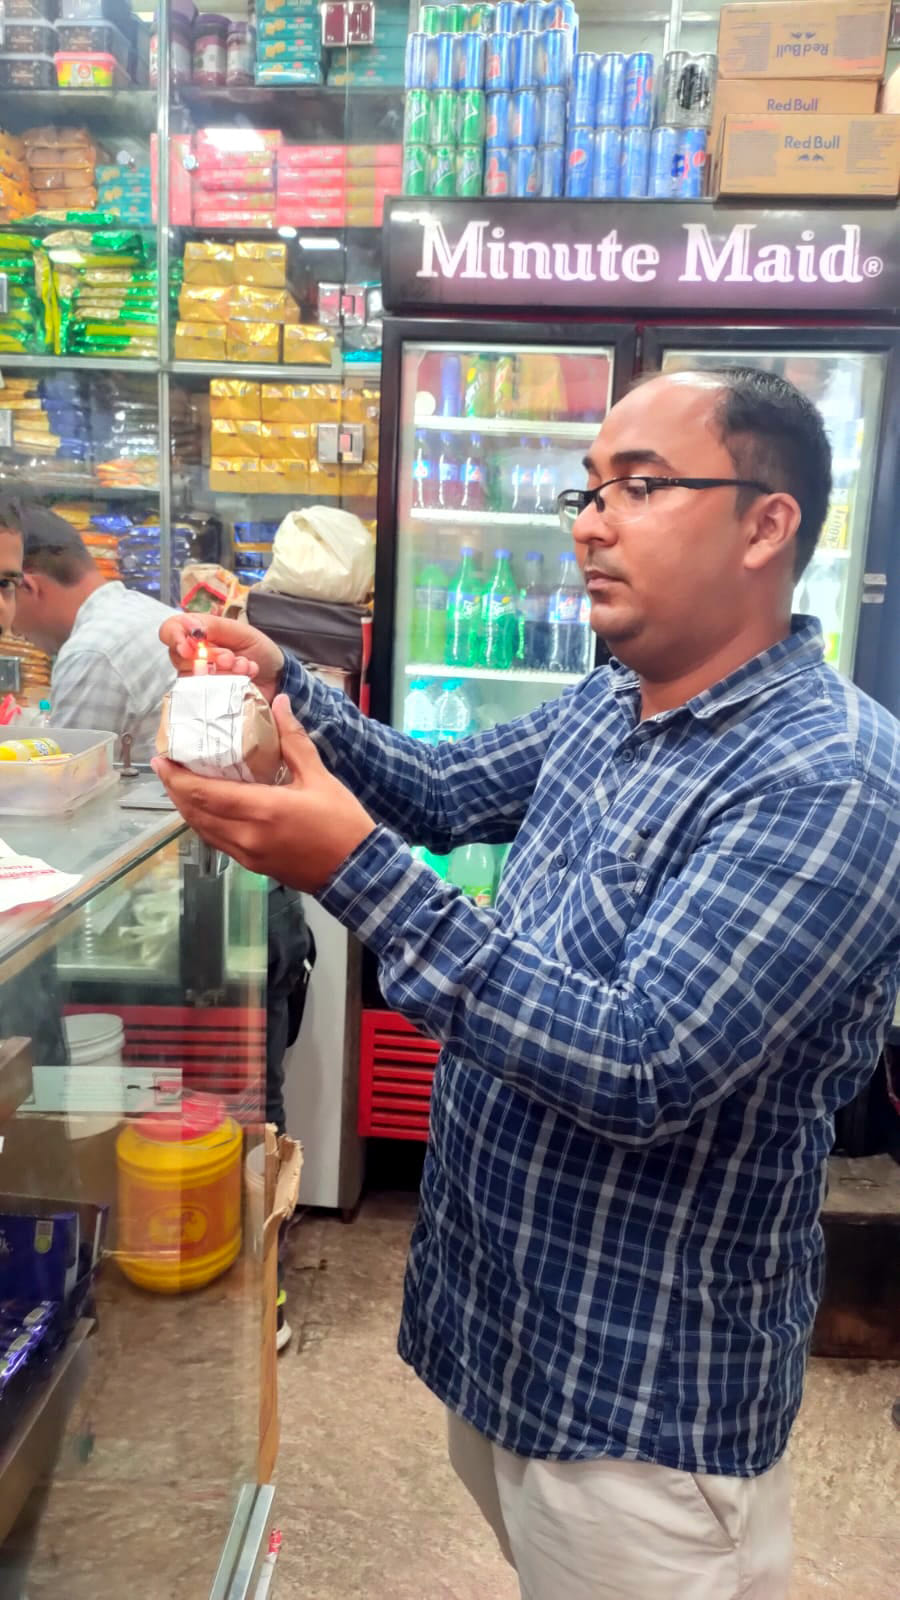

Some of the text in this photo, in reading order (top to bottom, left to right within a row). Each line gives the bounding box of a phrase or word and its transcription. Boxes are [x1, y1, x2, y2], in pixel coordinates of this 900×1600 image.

[776, 43, 829, 58] Red Bull
[767, 98, 818, 111] Red Bull
[784, 135, 841, 149] Red Bull
[415, 220, 660, 282] Minute
